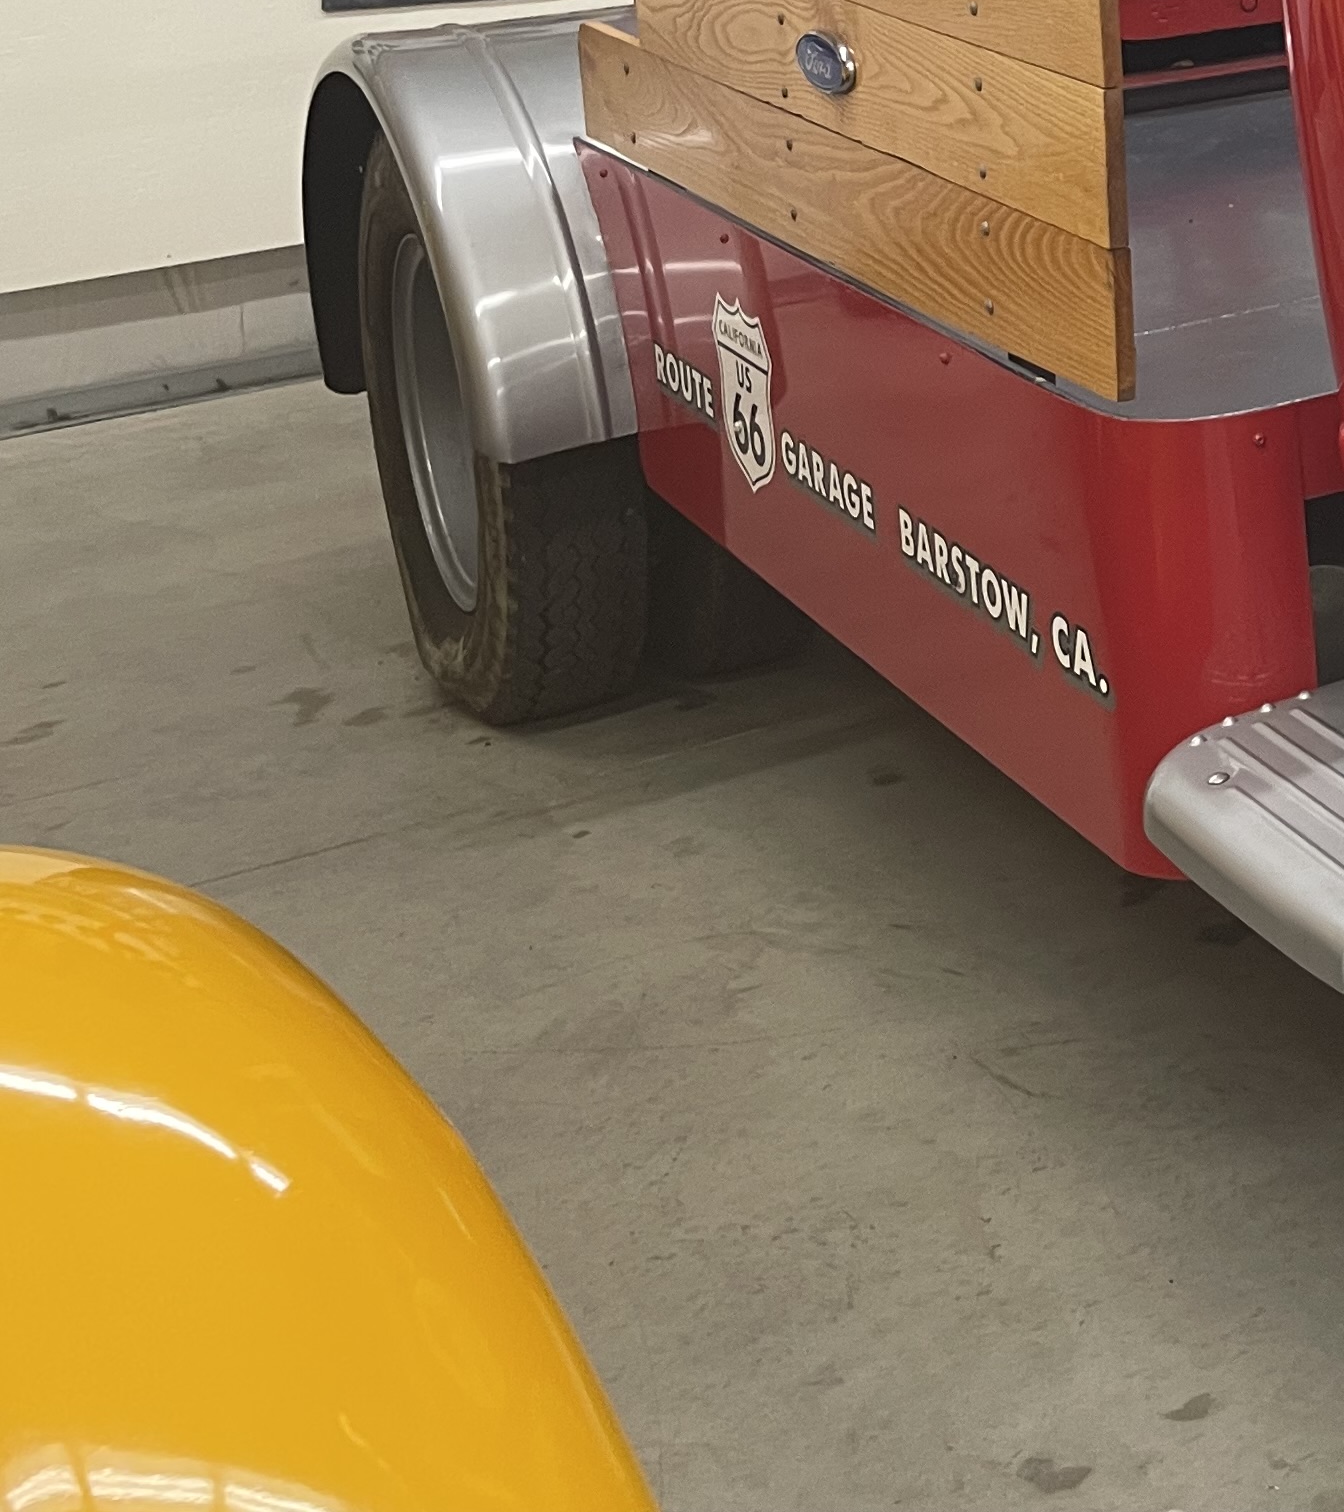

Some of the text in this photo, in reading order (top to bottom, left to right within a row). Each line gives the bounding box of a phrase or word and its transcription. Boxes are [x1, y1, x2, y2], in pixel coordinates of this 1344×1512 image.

[718, 318, 763, 356] CALIFORNIA
[735, 360, 752, 393] US
[733, 393, 766, 467] 66
[654, 343, 1109, 694] ROUTE GARAGE BARSTOW, CA.
